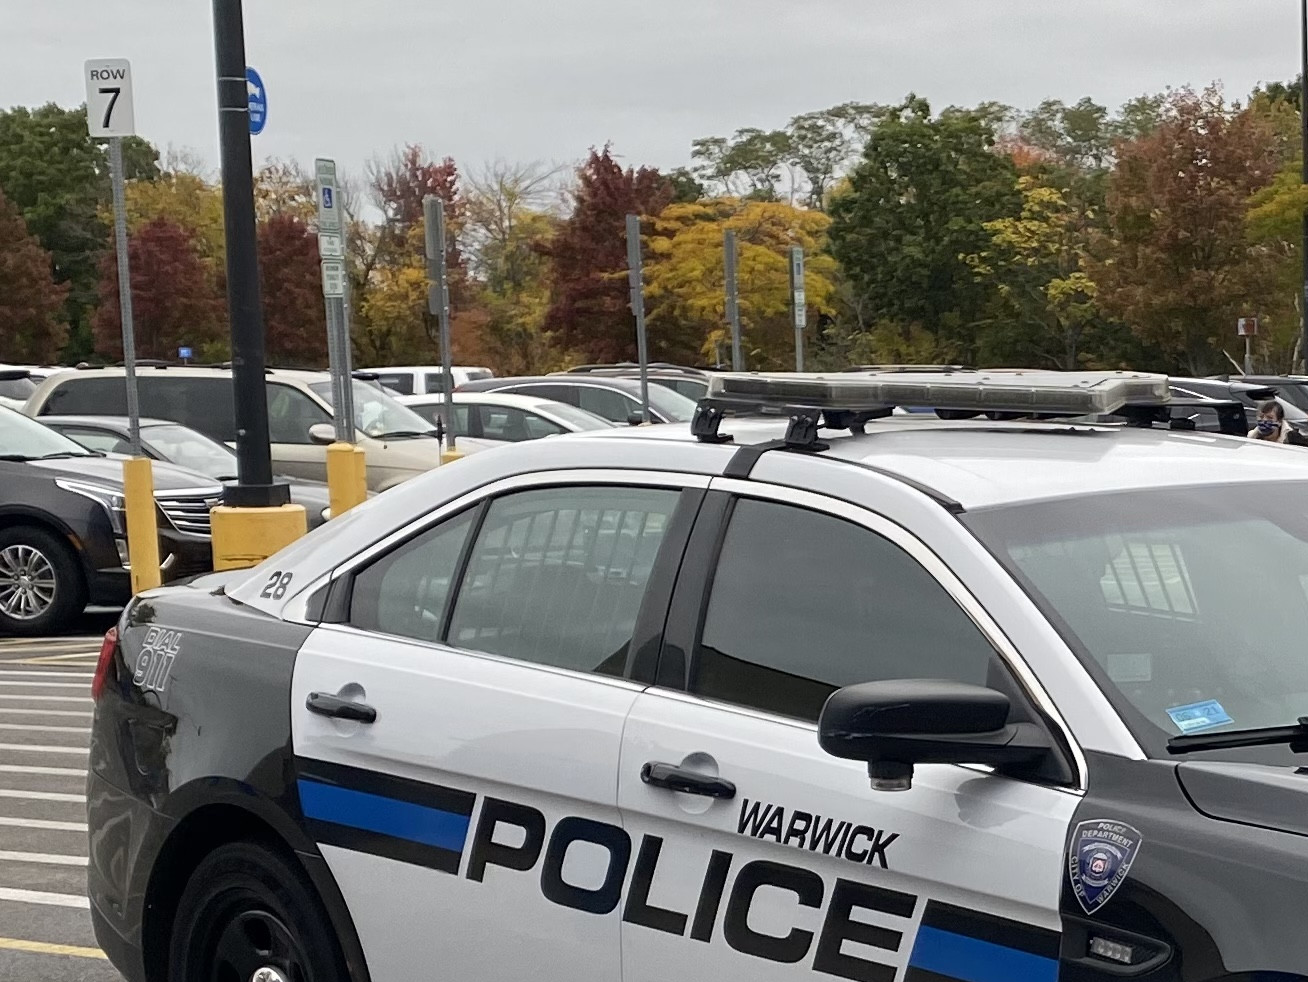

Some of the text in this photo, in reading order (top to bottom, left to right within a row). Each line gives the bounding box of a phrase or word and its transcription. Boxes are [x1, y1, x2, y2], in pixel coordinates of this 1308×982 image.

[90, 68, 126, 81] ROW
[98, 87, 121, 129] 7
[259, 570, 294, 601] 28
[142, 626, 183, 655] DIAL
[132, 647, 175, 692] 911
[736, 798, 900, 869] WARWICK
[1081, 829, 1134, 848] DEPARTMENT
[1097, 822, 1127, 834] POLICE
[1070, 855, 1080, 880] CITY
[1075, 883, 1085, 897] OF
[1095, 861, 1130, 904] WARWICK
